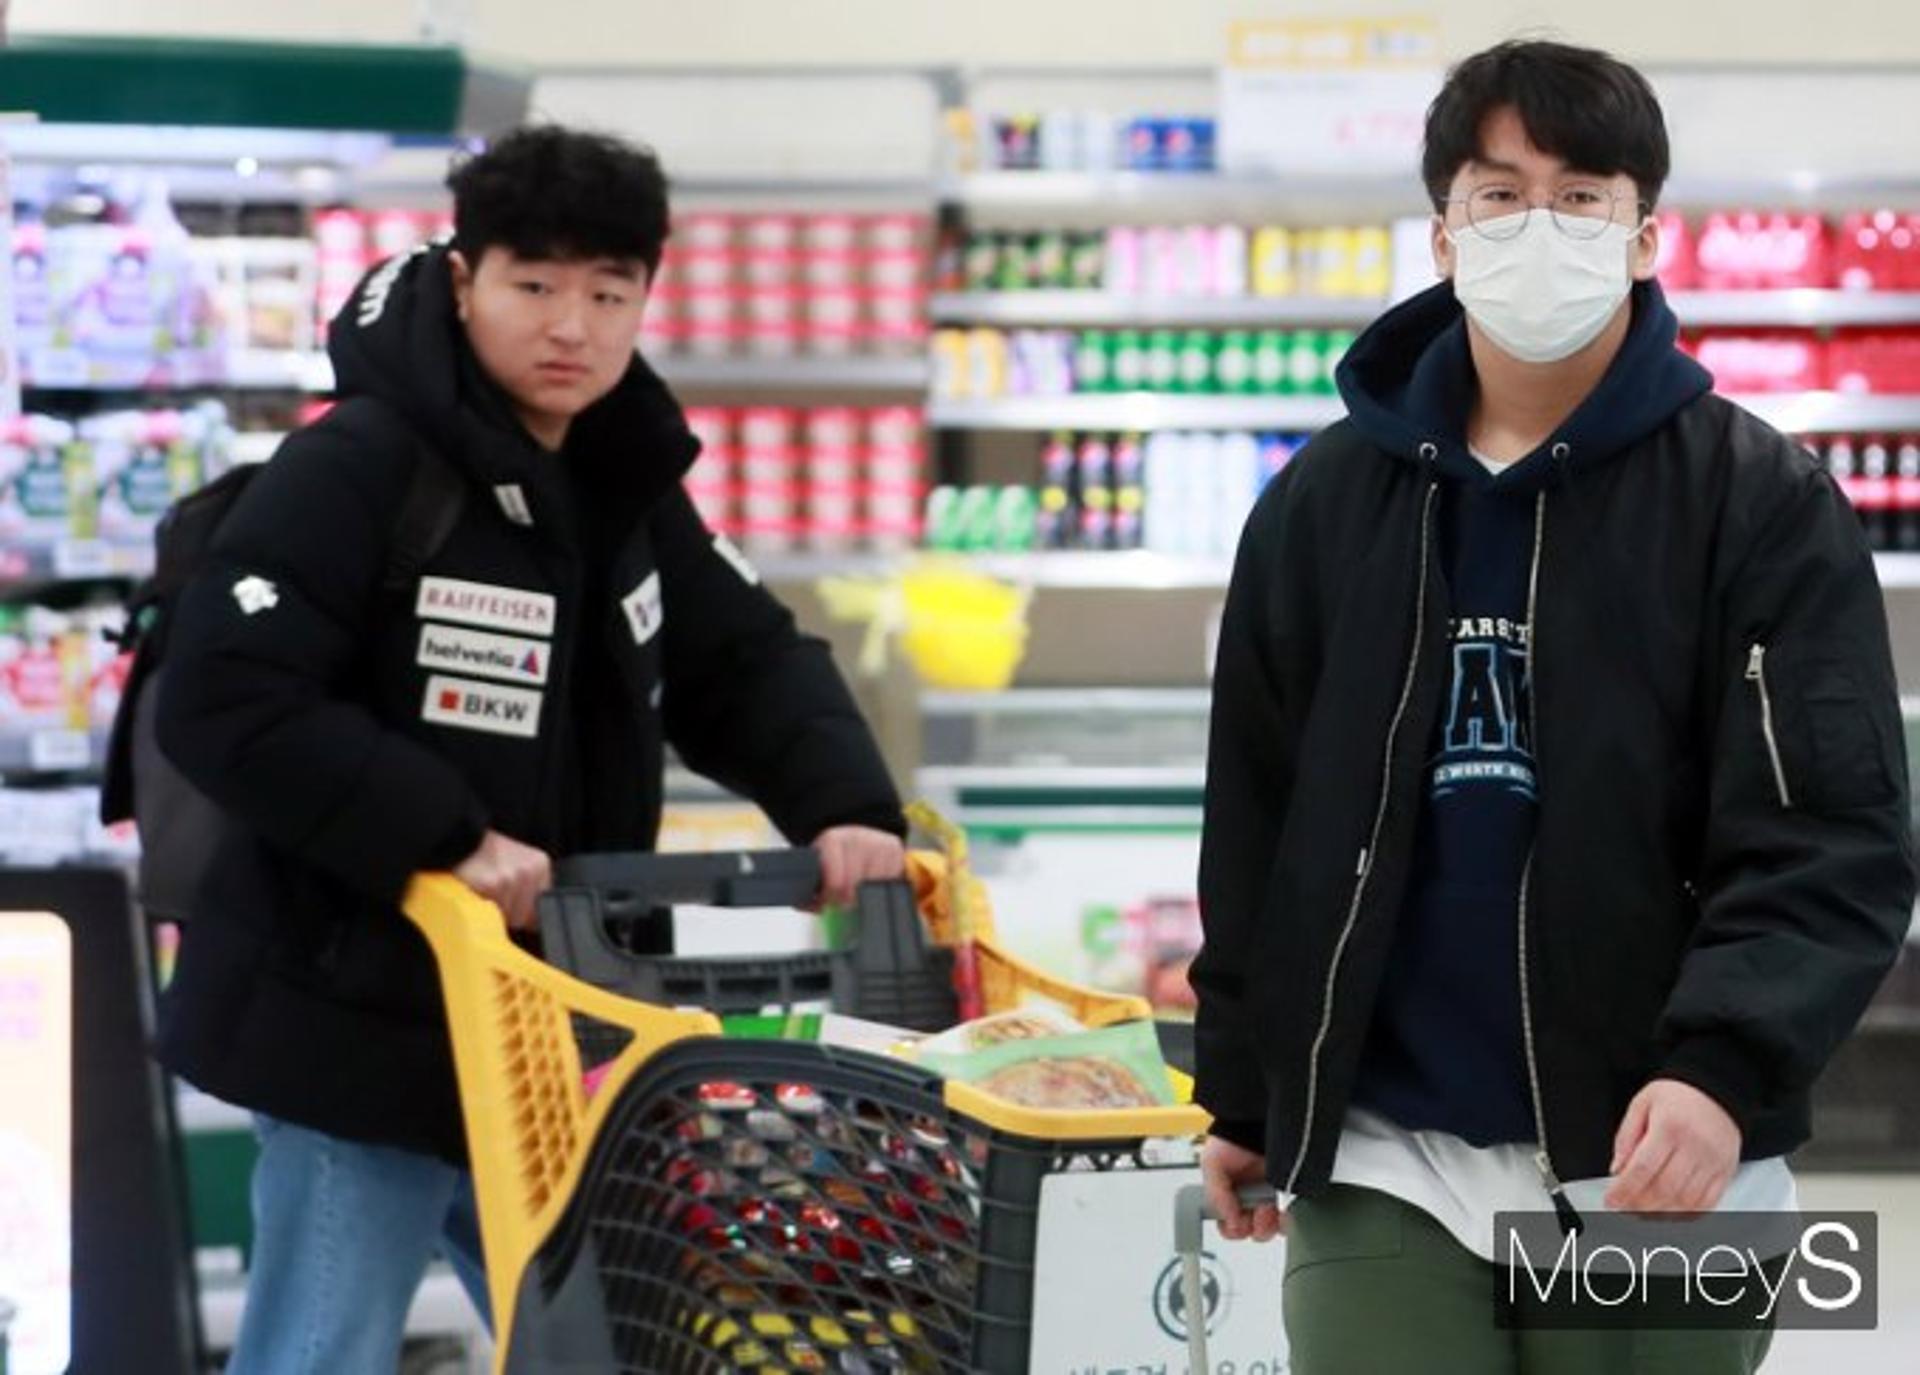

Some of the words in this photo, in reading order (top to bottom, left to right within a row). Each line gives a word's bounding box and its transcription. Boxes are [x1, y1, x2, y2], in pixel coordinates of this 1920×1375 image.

[425, 587, 547, 621] RAIFFEISEN
[426, 637, 515, 668] helvetia
[464, 693, 529, 722] BKW
